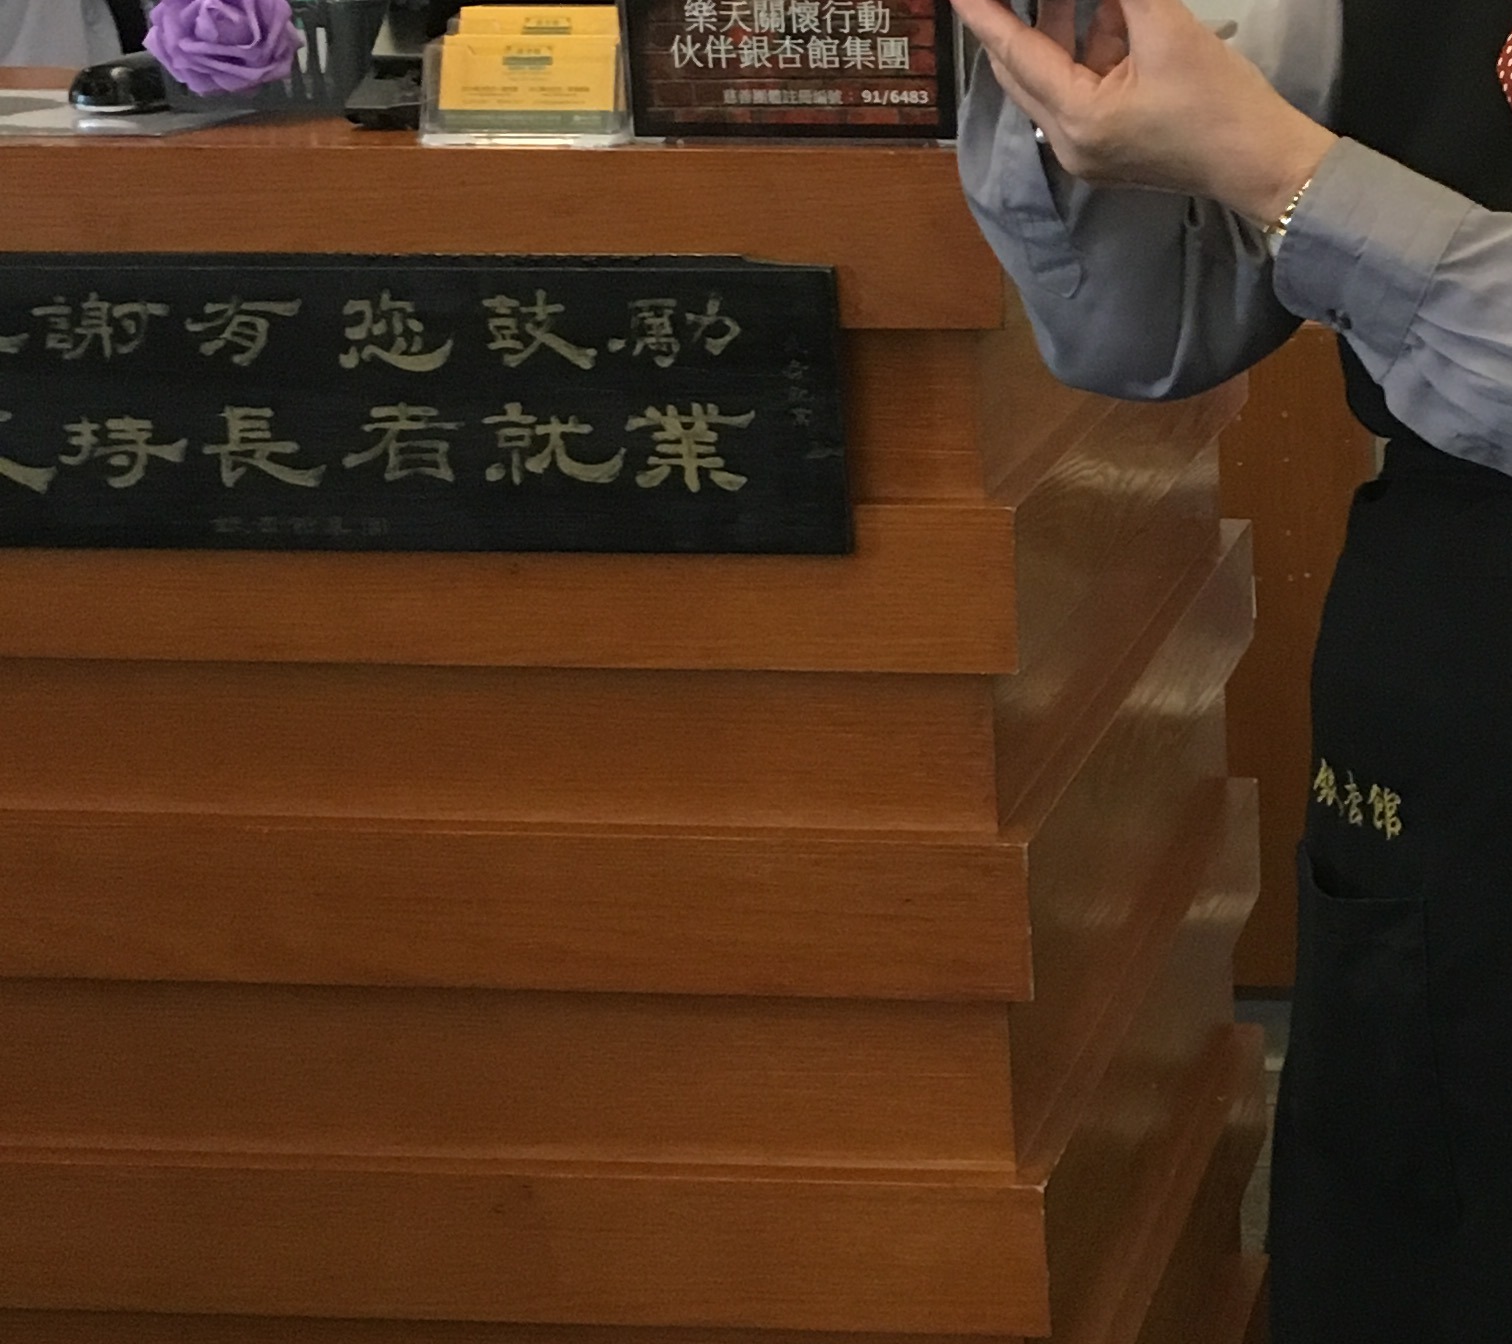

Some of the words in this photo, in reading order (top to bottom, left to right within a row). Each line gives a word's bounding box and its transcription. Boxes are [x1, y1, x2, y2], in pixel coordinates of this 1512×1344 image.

[670, 35, 911, 70] 伙伴銀杏館集團
[860, 89, 930, 105] 91/6483
[0, 288, 742, 373] 謝有您鼓勵
